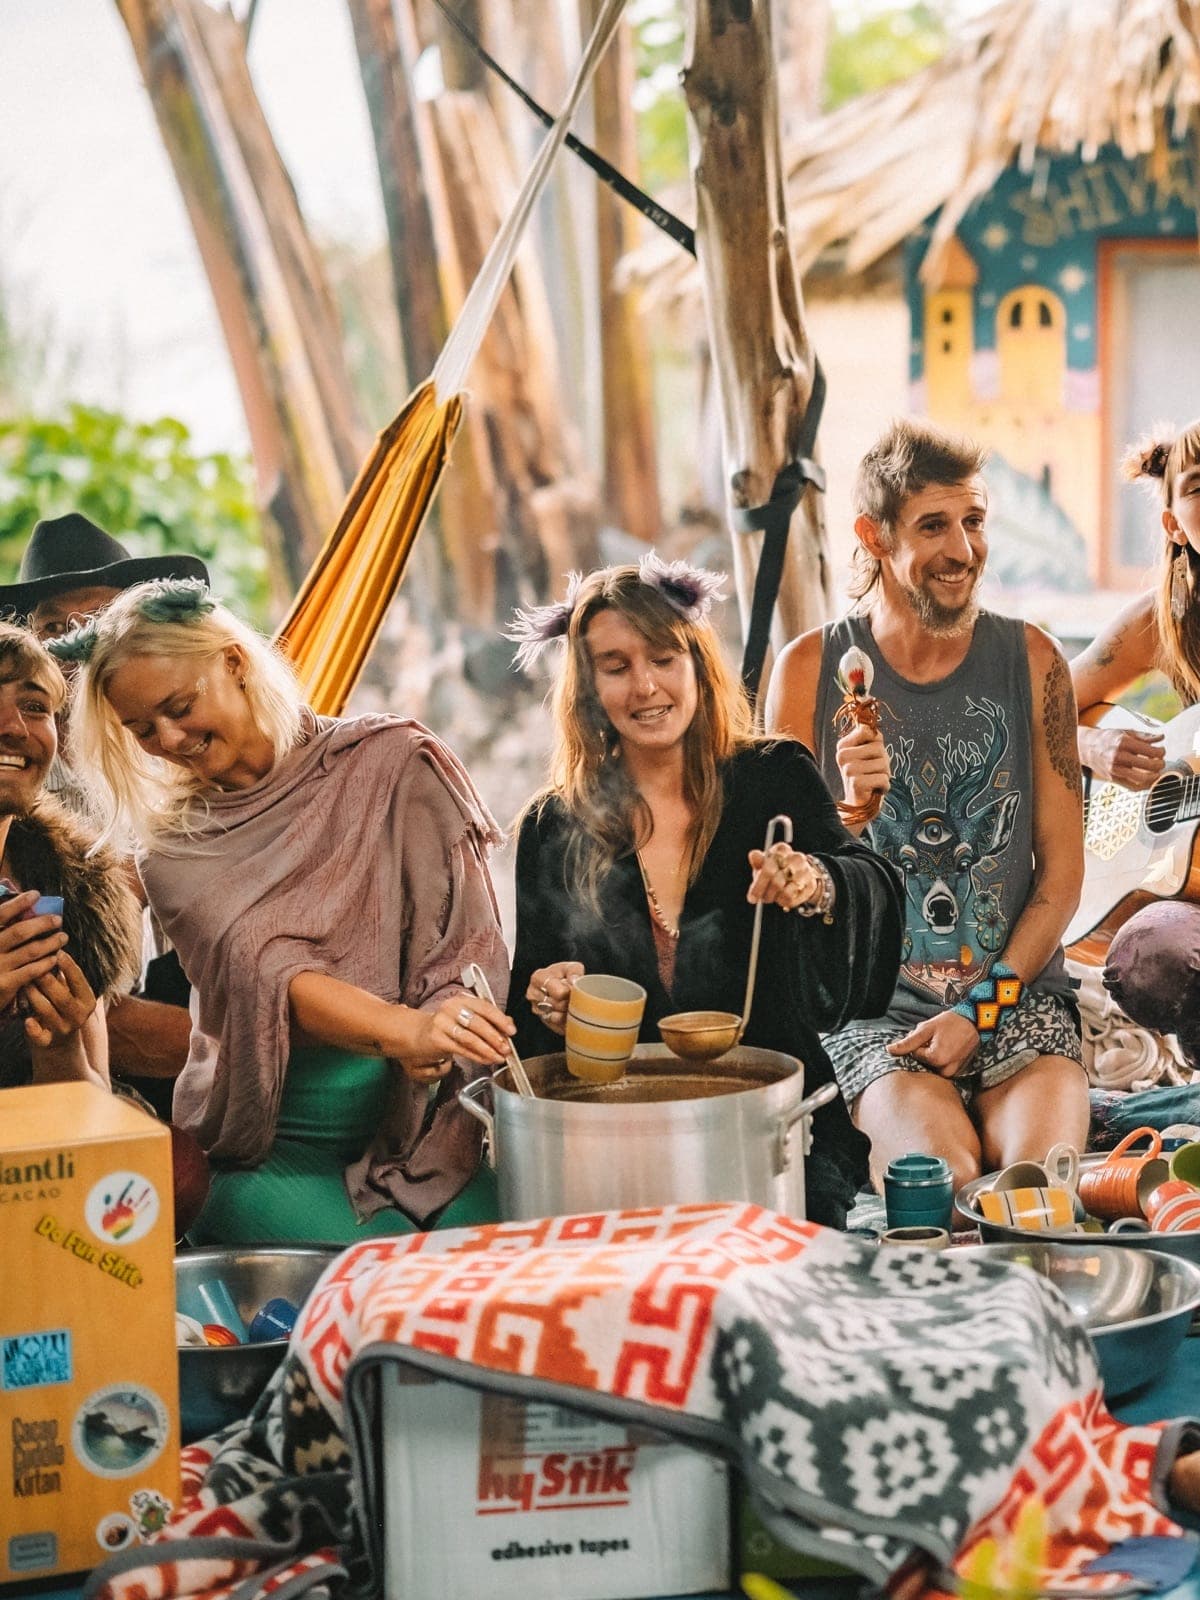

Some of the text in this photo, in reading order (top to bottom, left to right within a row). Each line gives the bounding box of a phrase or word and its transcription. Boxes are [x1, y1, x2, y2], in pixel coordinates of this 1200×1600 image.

[62, 1230, 99, 1265] Fun
[490, 1538, 630, 1561] adhesive tapes
